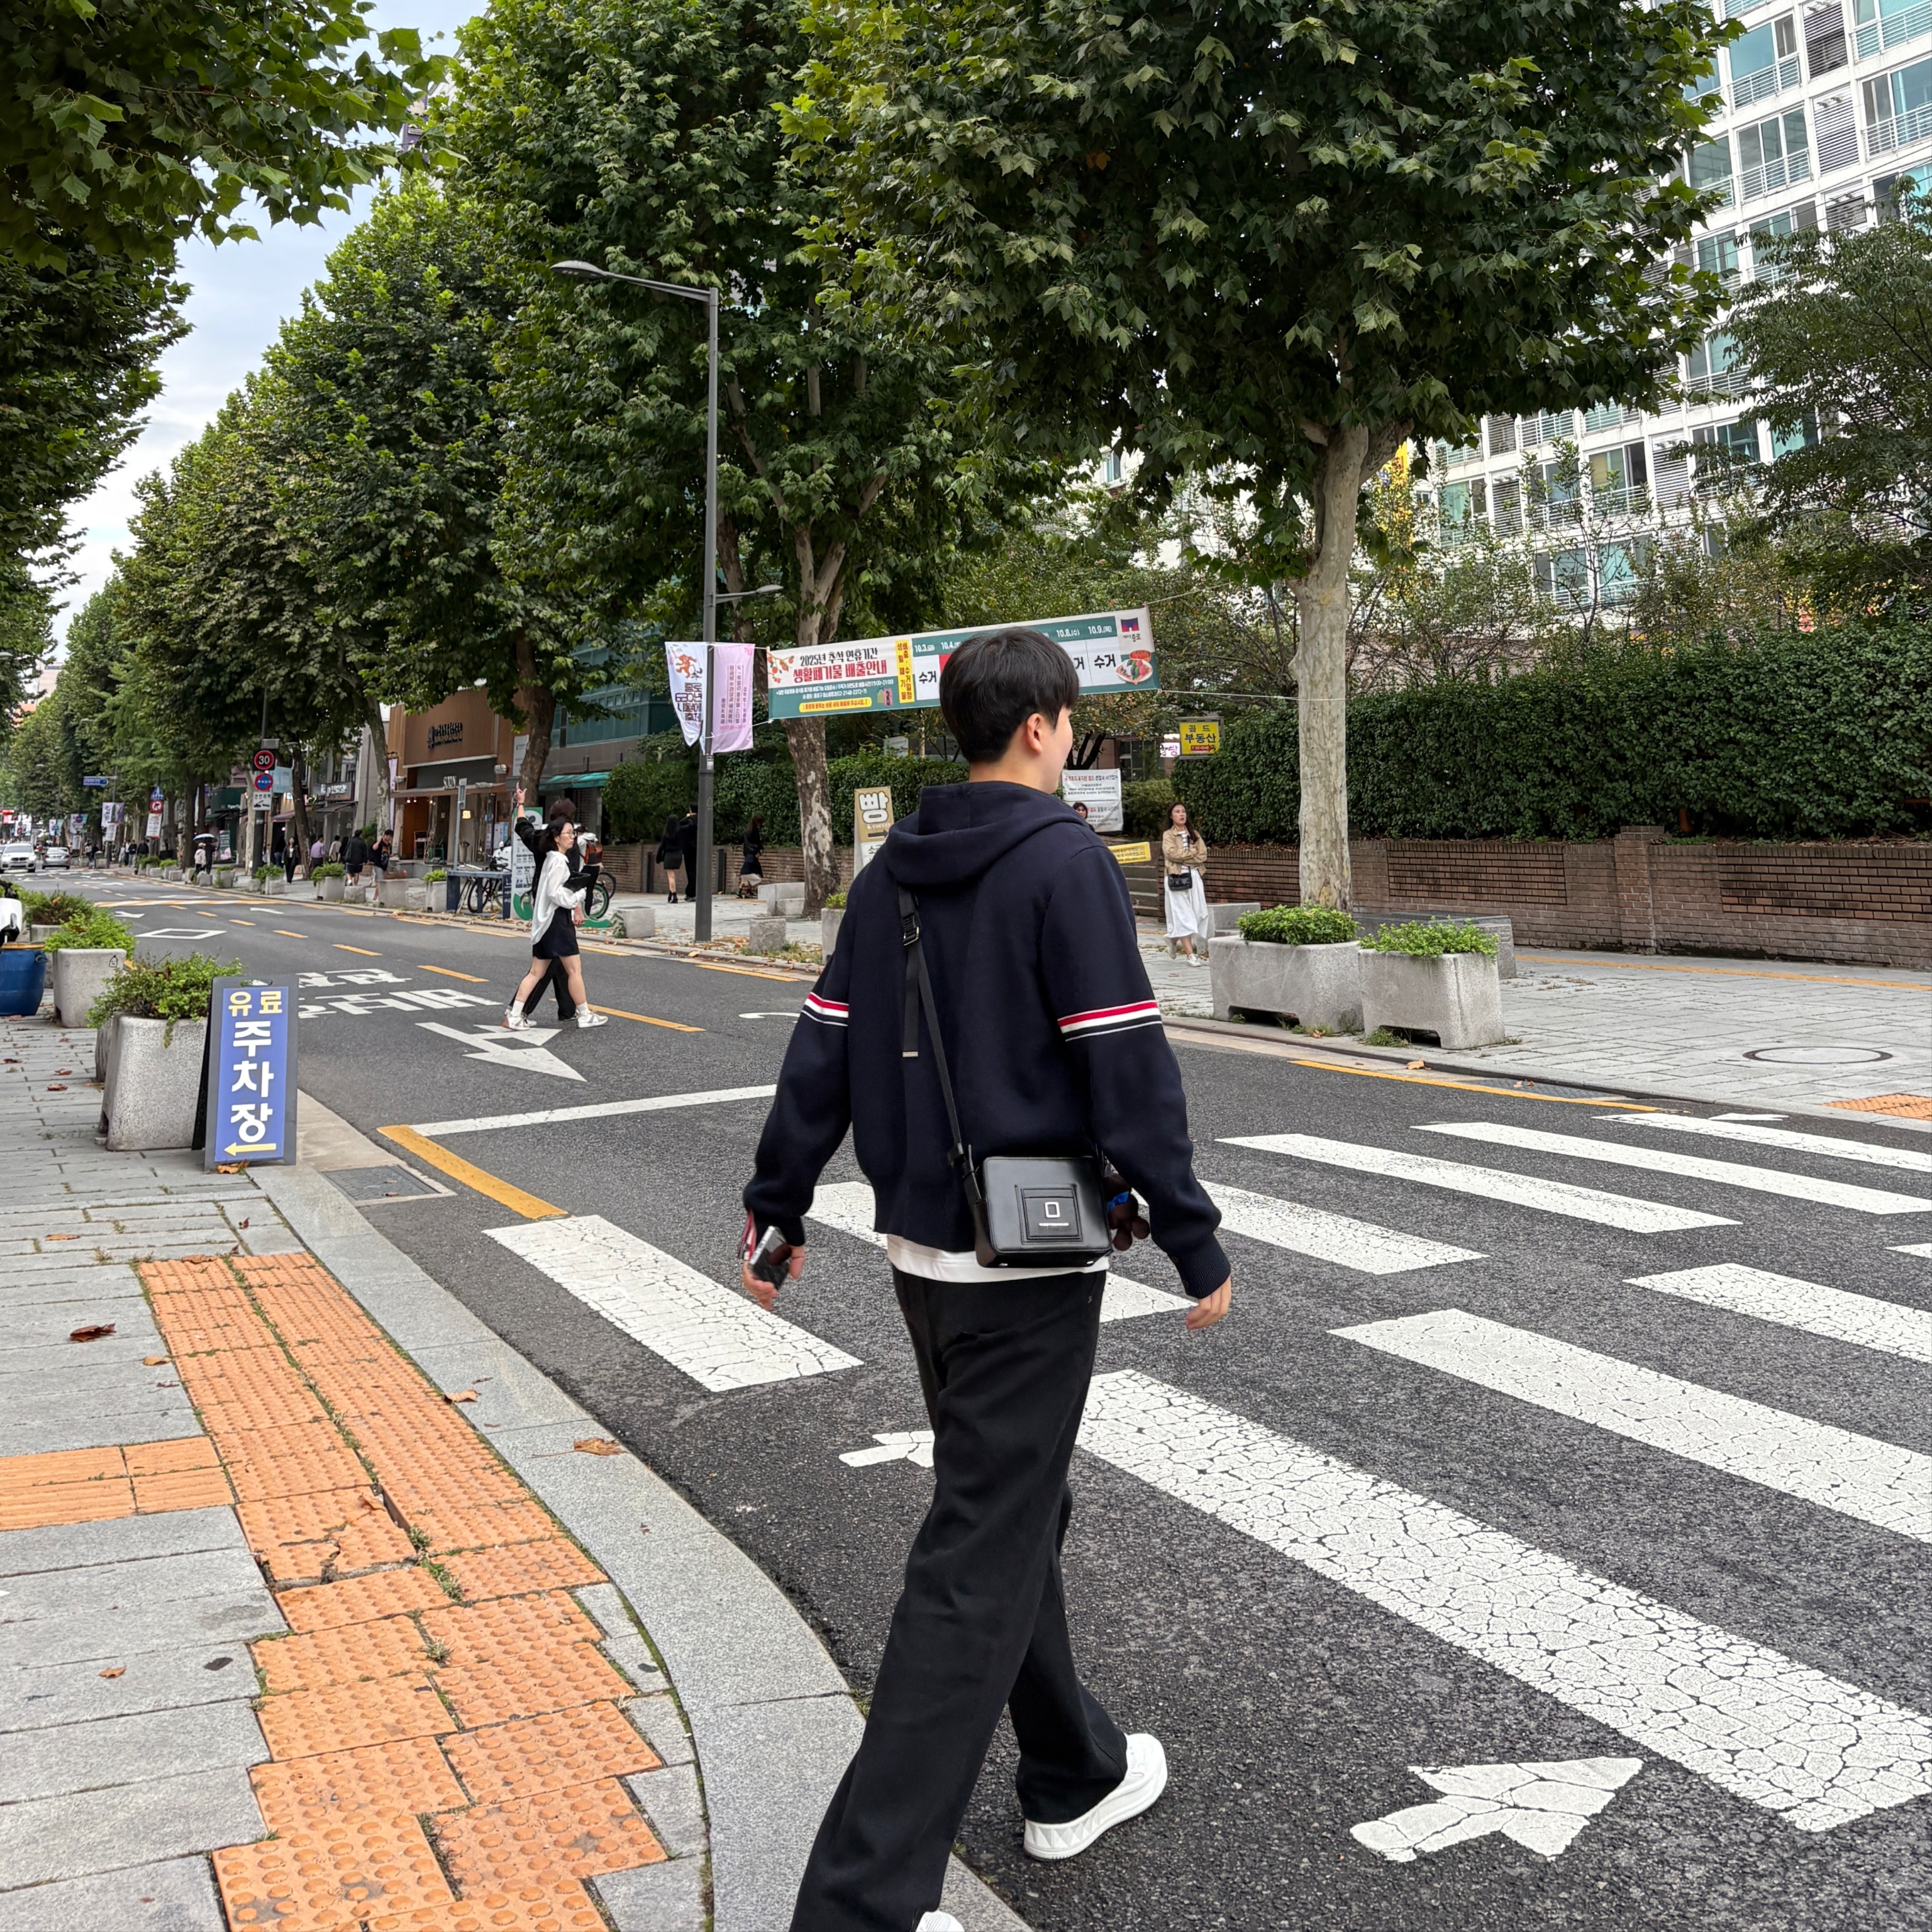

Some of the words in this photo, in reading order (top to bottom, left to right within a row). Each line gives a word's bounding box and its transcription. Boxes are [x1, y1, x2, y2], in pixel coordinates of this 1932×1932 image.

[1057, 628, 1080, 638] 10.8.(수)
[800, 652, 826, 667] 2025년
[828, 650, 844, 663] 추석
[846, 647, 878, 662] 연휴기간
[919, 670, 936, 684] 수거
[1074, 657, 1085, 670] 거
[1094, 653, 1116, 669] 수거
[793, 663, 843, 684] 생활폐기물
[845, 659, 887, 678] 배출안내
[1184, 733, 1216, 744] 부동산
[258, 755, 270, 765] 30
[858, 791, 889, 824] 빵
[228, 991, 282, 1017] 유료
[230, 1021, 274, 1143] 주차장
